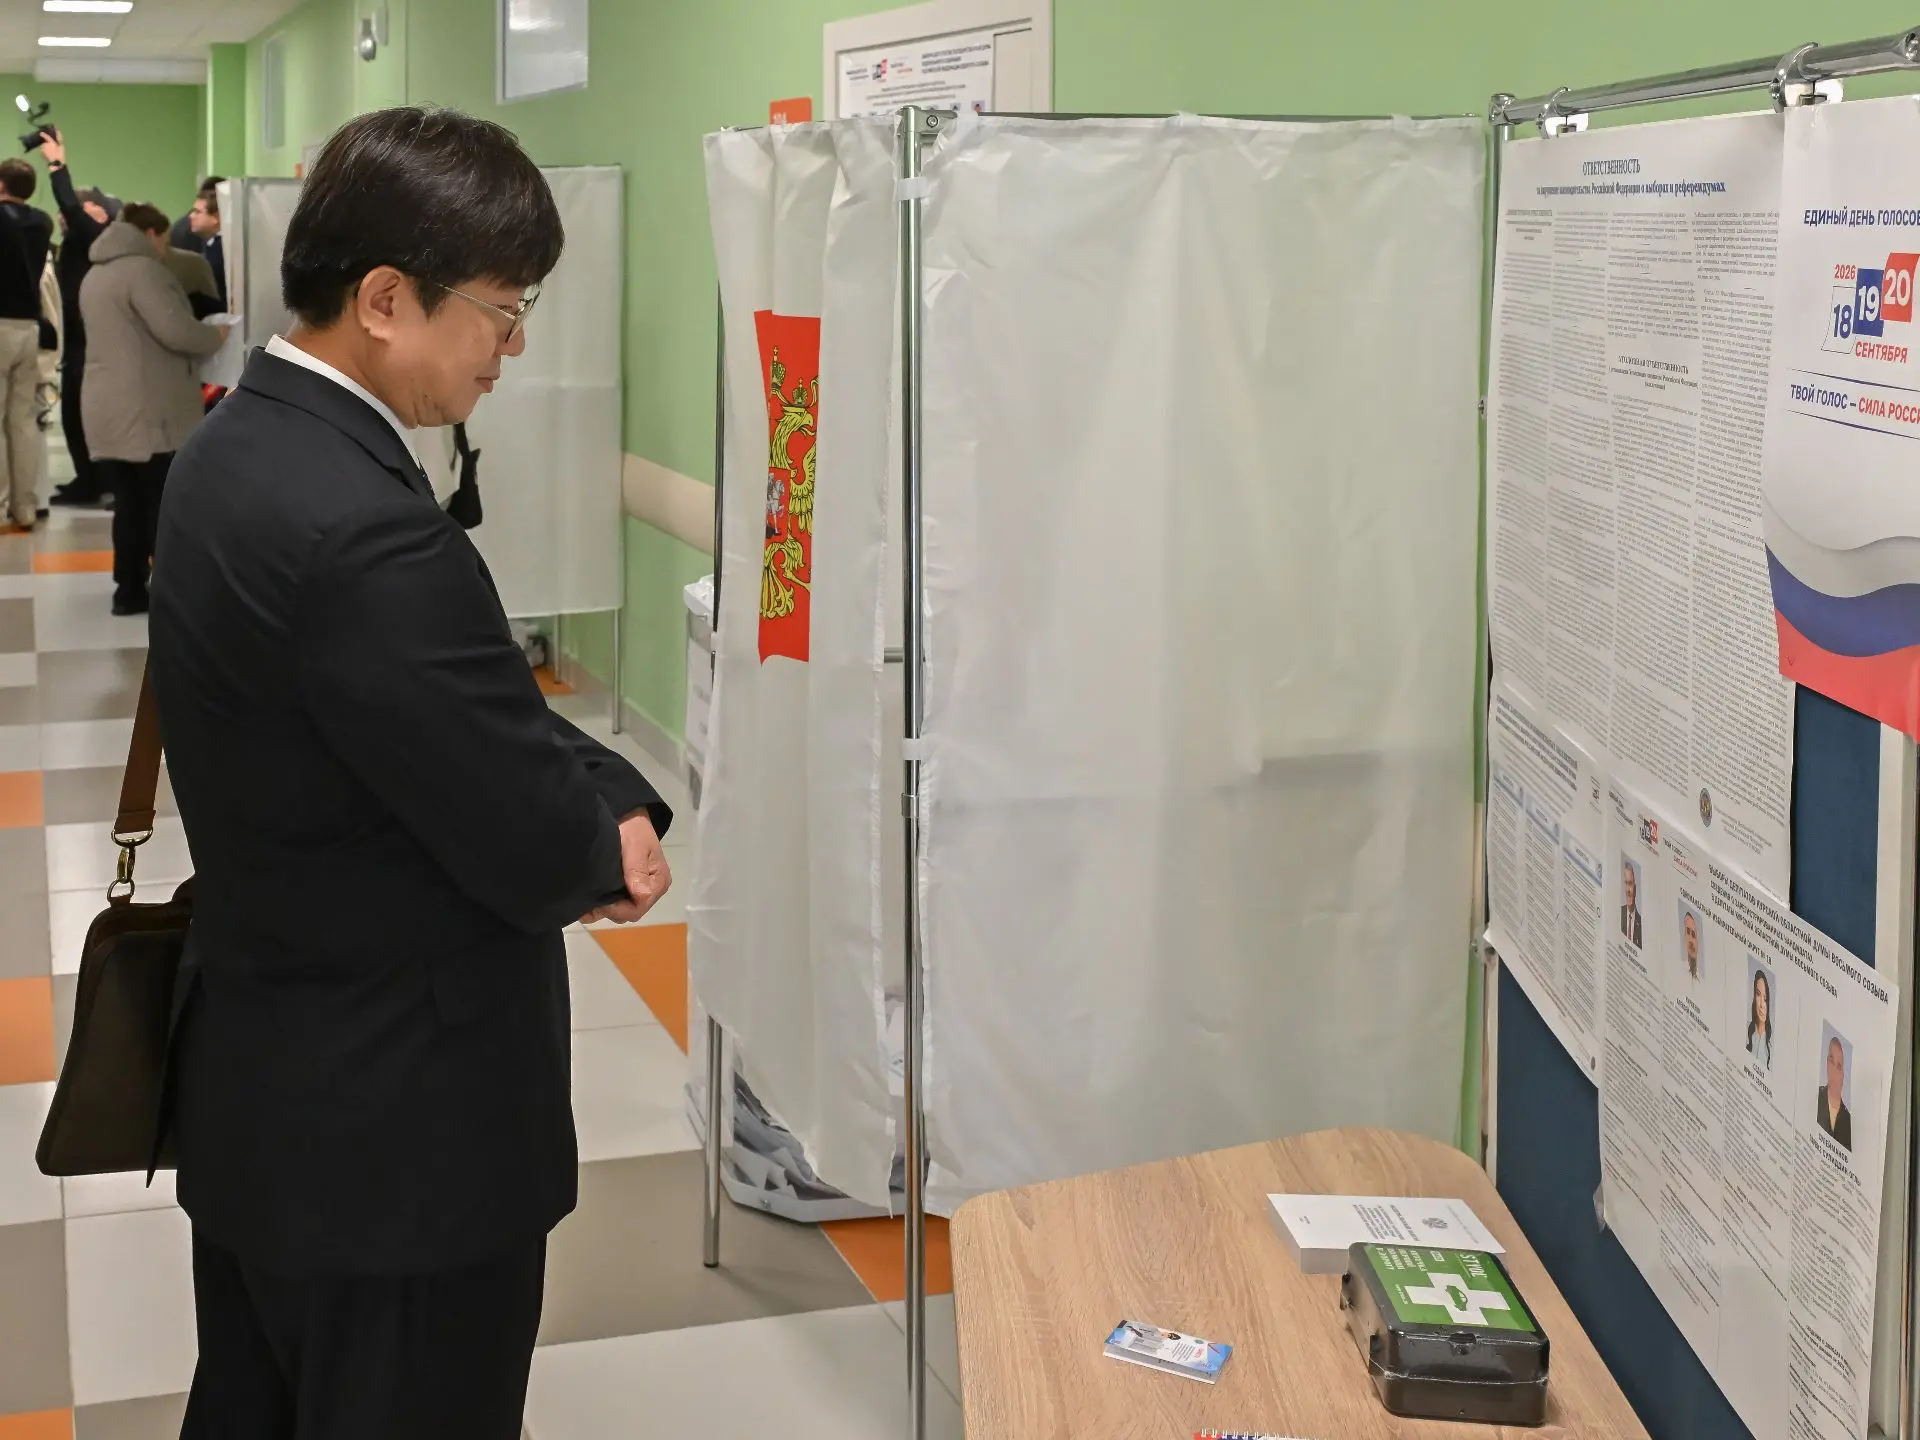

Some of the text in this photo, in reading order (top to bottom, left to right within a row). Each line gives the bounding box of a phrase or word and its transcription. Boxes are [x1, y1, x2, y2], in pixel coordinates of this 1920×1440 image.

[1582, 158, 1640, 176] ОТВЕТСТВЕННОСТЬ
[1645, 180, 1668, 196] выборах
[1669, 183, 1674, 193] и
[1674, 178, 1726, 198] референдумах
[1804, 206, 1848, 226] ЕДИНЫЙ
[1849, 210, 1874, 227] ДЕНЬ
[1834, 264, 1856, 280] 2026
[1884, 268, 1911, 306] 20
[1858, 286, 1880, 322] 19
[1834, 304, 1852, 339] 18
[1856, 341, 1908, 364] СЕНТЯБРЯ
[1791, 384, 1814, 402] ТВОЙ
[1816, 389, 1848, 410] ГОЛОС
[1858, 397, 1886, 418] СИЛА
[1780, 916, 1812, 949] ОБЛАСТНОЙ
[1812, 939, 1831, 961] ДУМЫ
[1832, 952, 1862, 984] ВОСЬМОГО
[1862, 976, 1888, 1005] СОЗЫВА
[1819, 976, 1838, 998] СОЗЫВА
